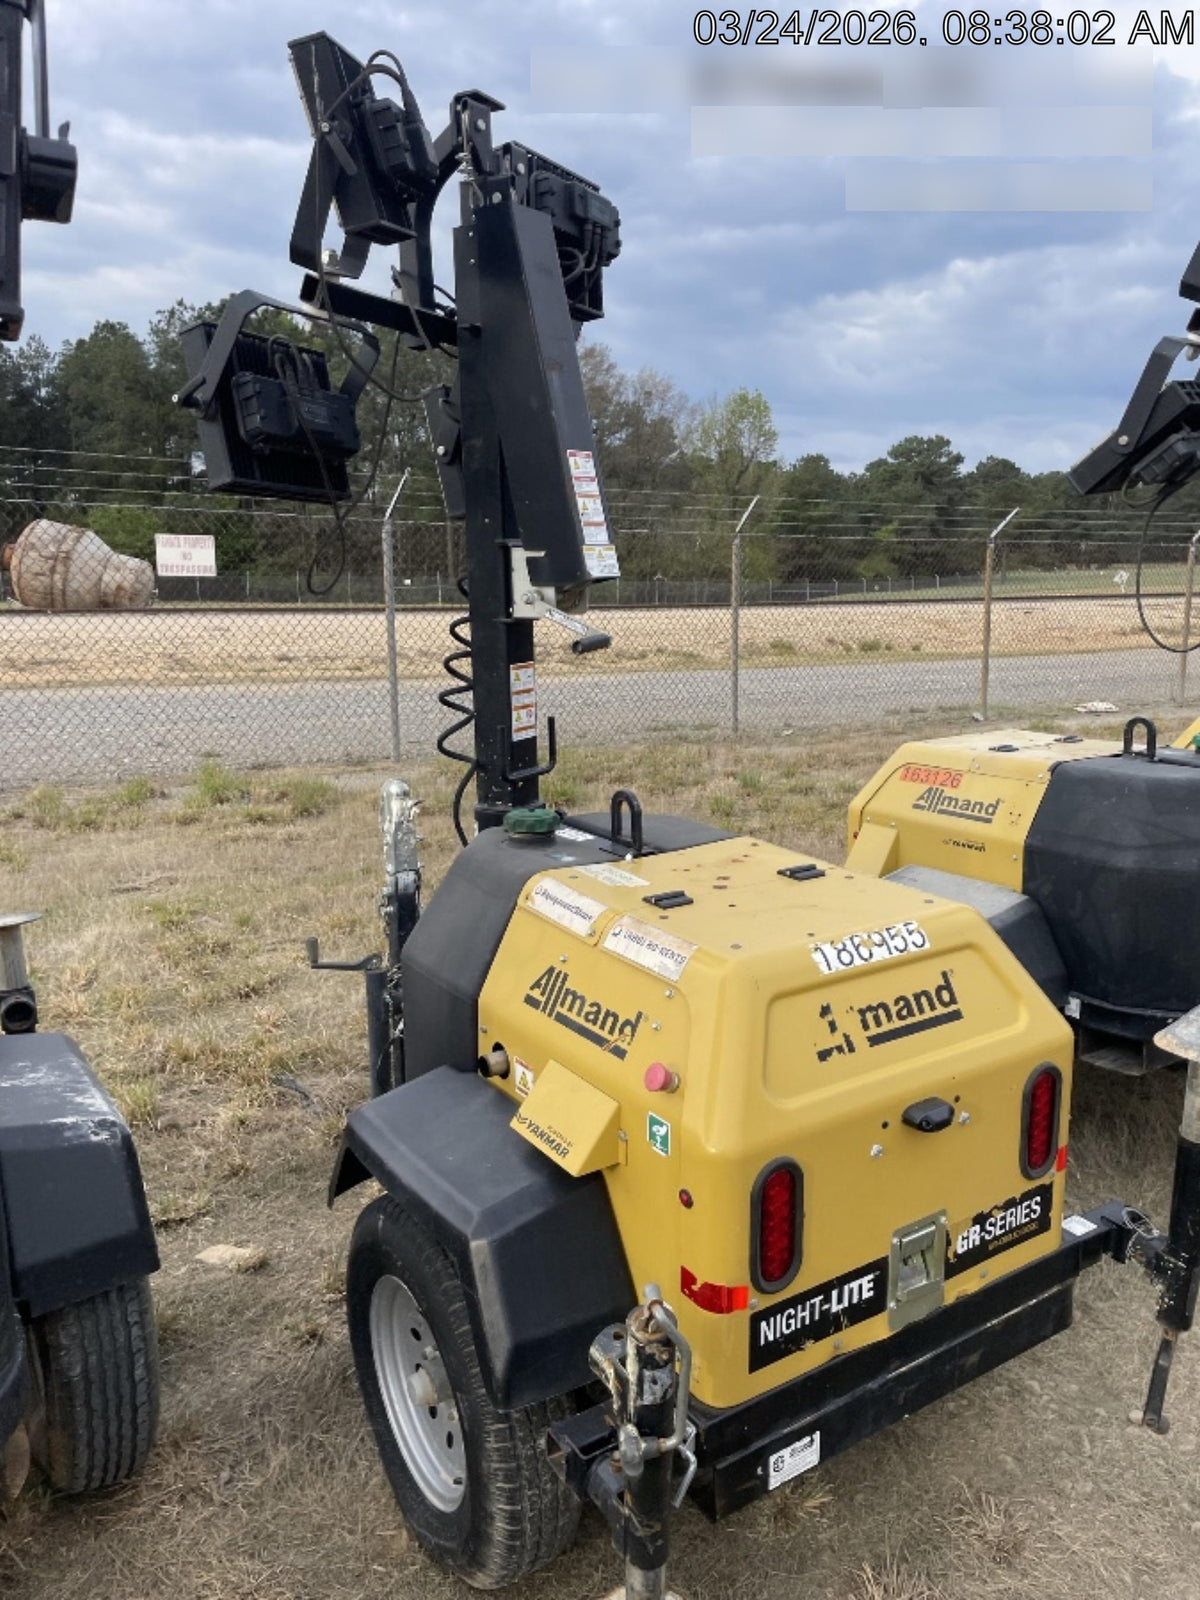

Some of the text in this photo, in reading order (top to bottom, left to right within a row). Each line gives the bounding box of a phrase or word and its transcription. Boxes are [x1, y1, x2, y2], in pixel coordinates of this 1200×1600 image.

[902, 766, 963, 788] 163126
[915, 786, 1000, 817] Allmand
[814, 921, 926, 971] 186955
[529, 965, 643, 1047] Allmand
[526, 1119, 570, 1159] YANMAR
[956, 1195, 1042, 1254] GR-SERIES
[760, 1273, 875, 1347] NIGHT-LITE
